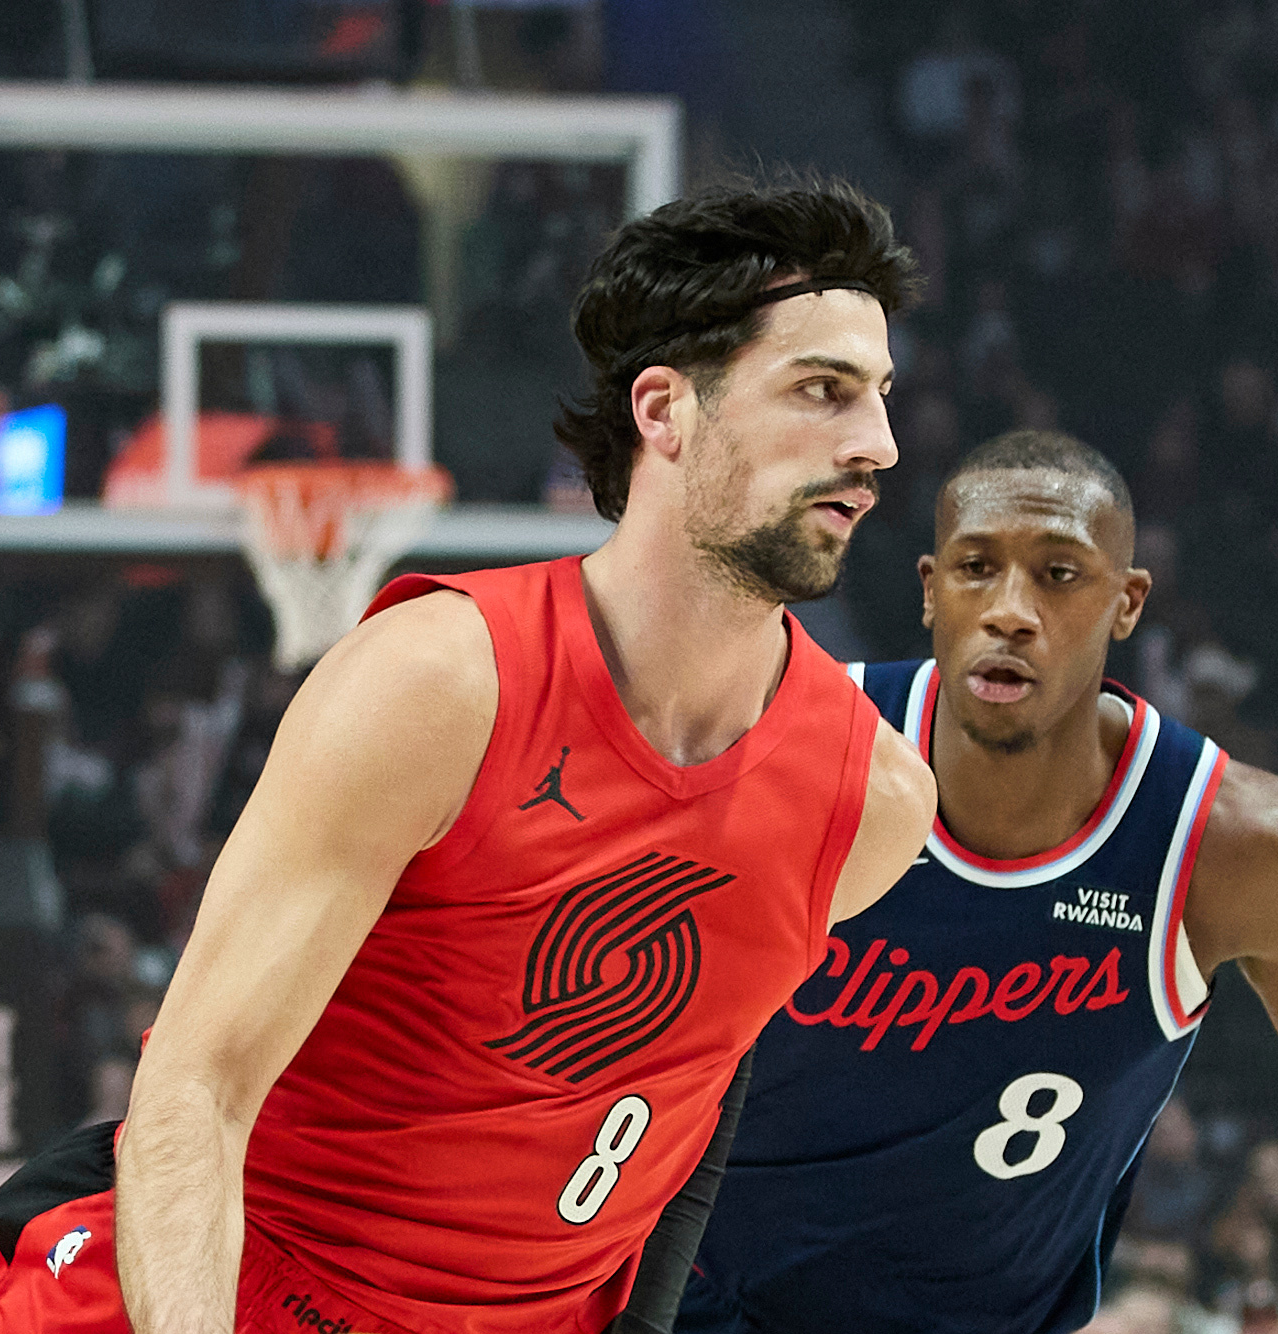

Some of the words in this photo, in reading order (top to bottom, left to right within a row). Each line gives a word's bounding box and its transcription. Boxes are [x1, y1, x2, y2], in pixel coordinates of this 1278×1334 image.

[1052, 901, 1144, 932] RWANDA
[1077, 887, 1130, 912] VISIT
[783, 936, 1131, 1052] Clippers
[557, 1093, 652, 1226] 8
[973, 1071, 1085, 1181] 8
